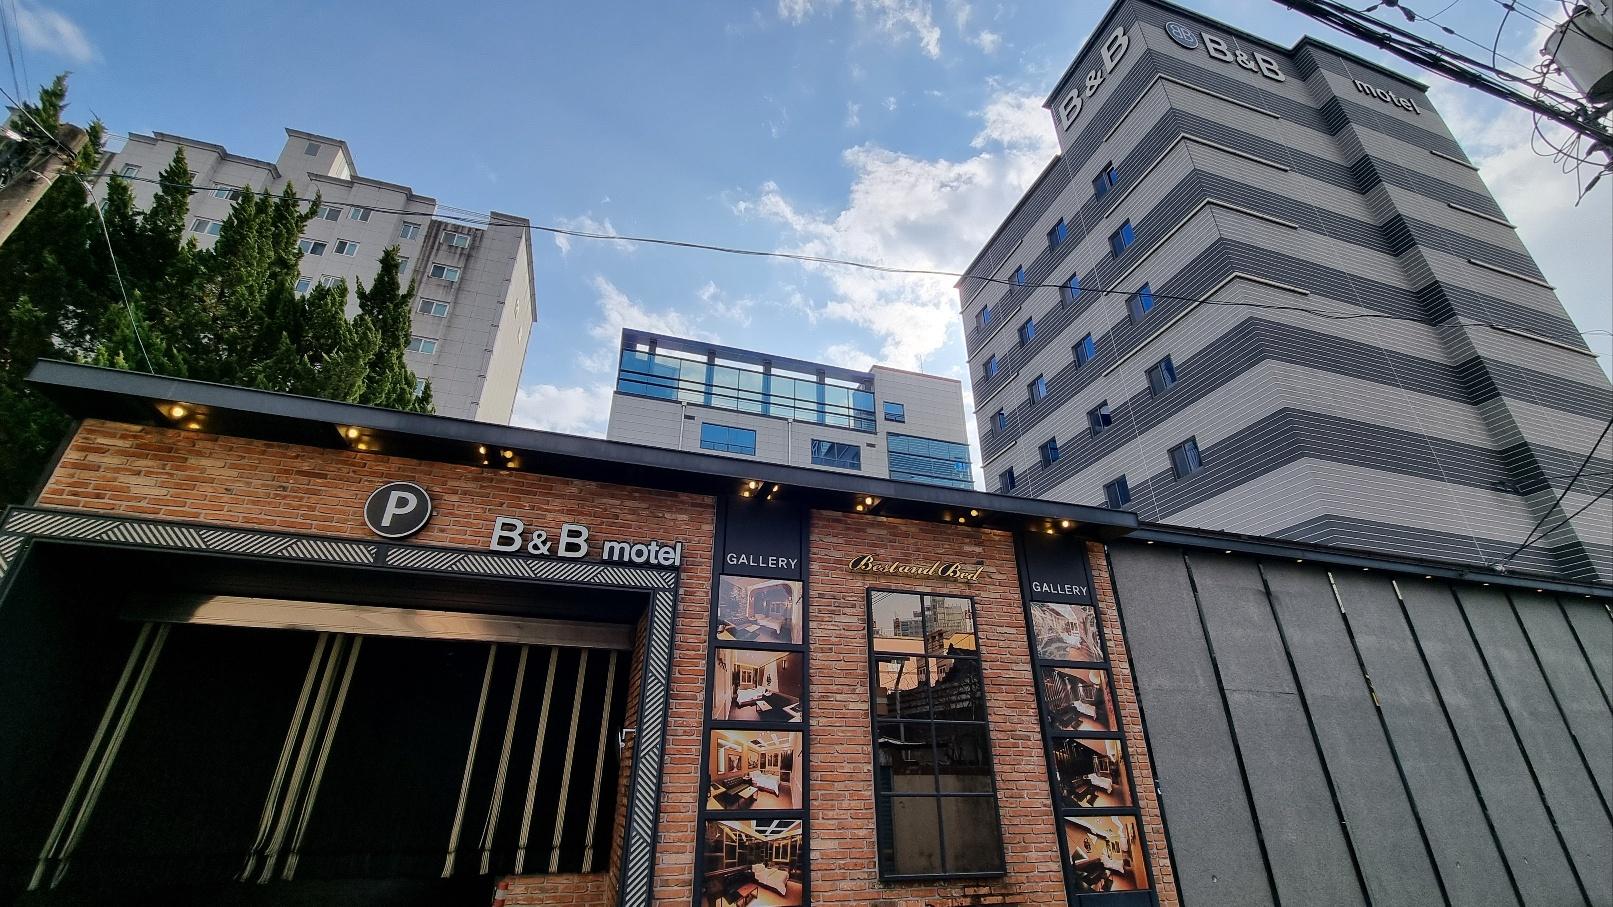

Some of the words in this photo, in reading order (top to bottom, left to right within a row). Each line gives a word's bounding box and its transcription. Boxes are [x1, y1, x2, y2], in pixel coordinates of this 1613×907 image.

[1353, 79, 1421, 115] motel
[381, 490, 418, 527] P
[602, 540, 682, 566] motel
[726, 553, 798, 569] GALLERY
[937, 562, 984, 581] Bed
[1032, 581, 1087, 596] GALLERY
